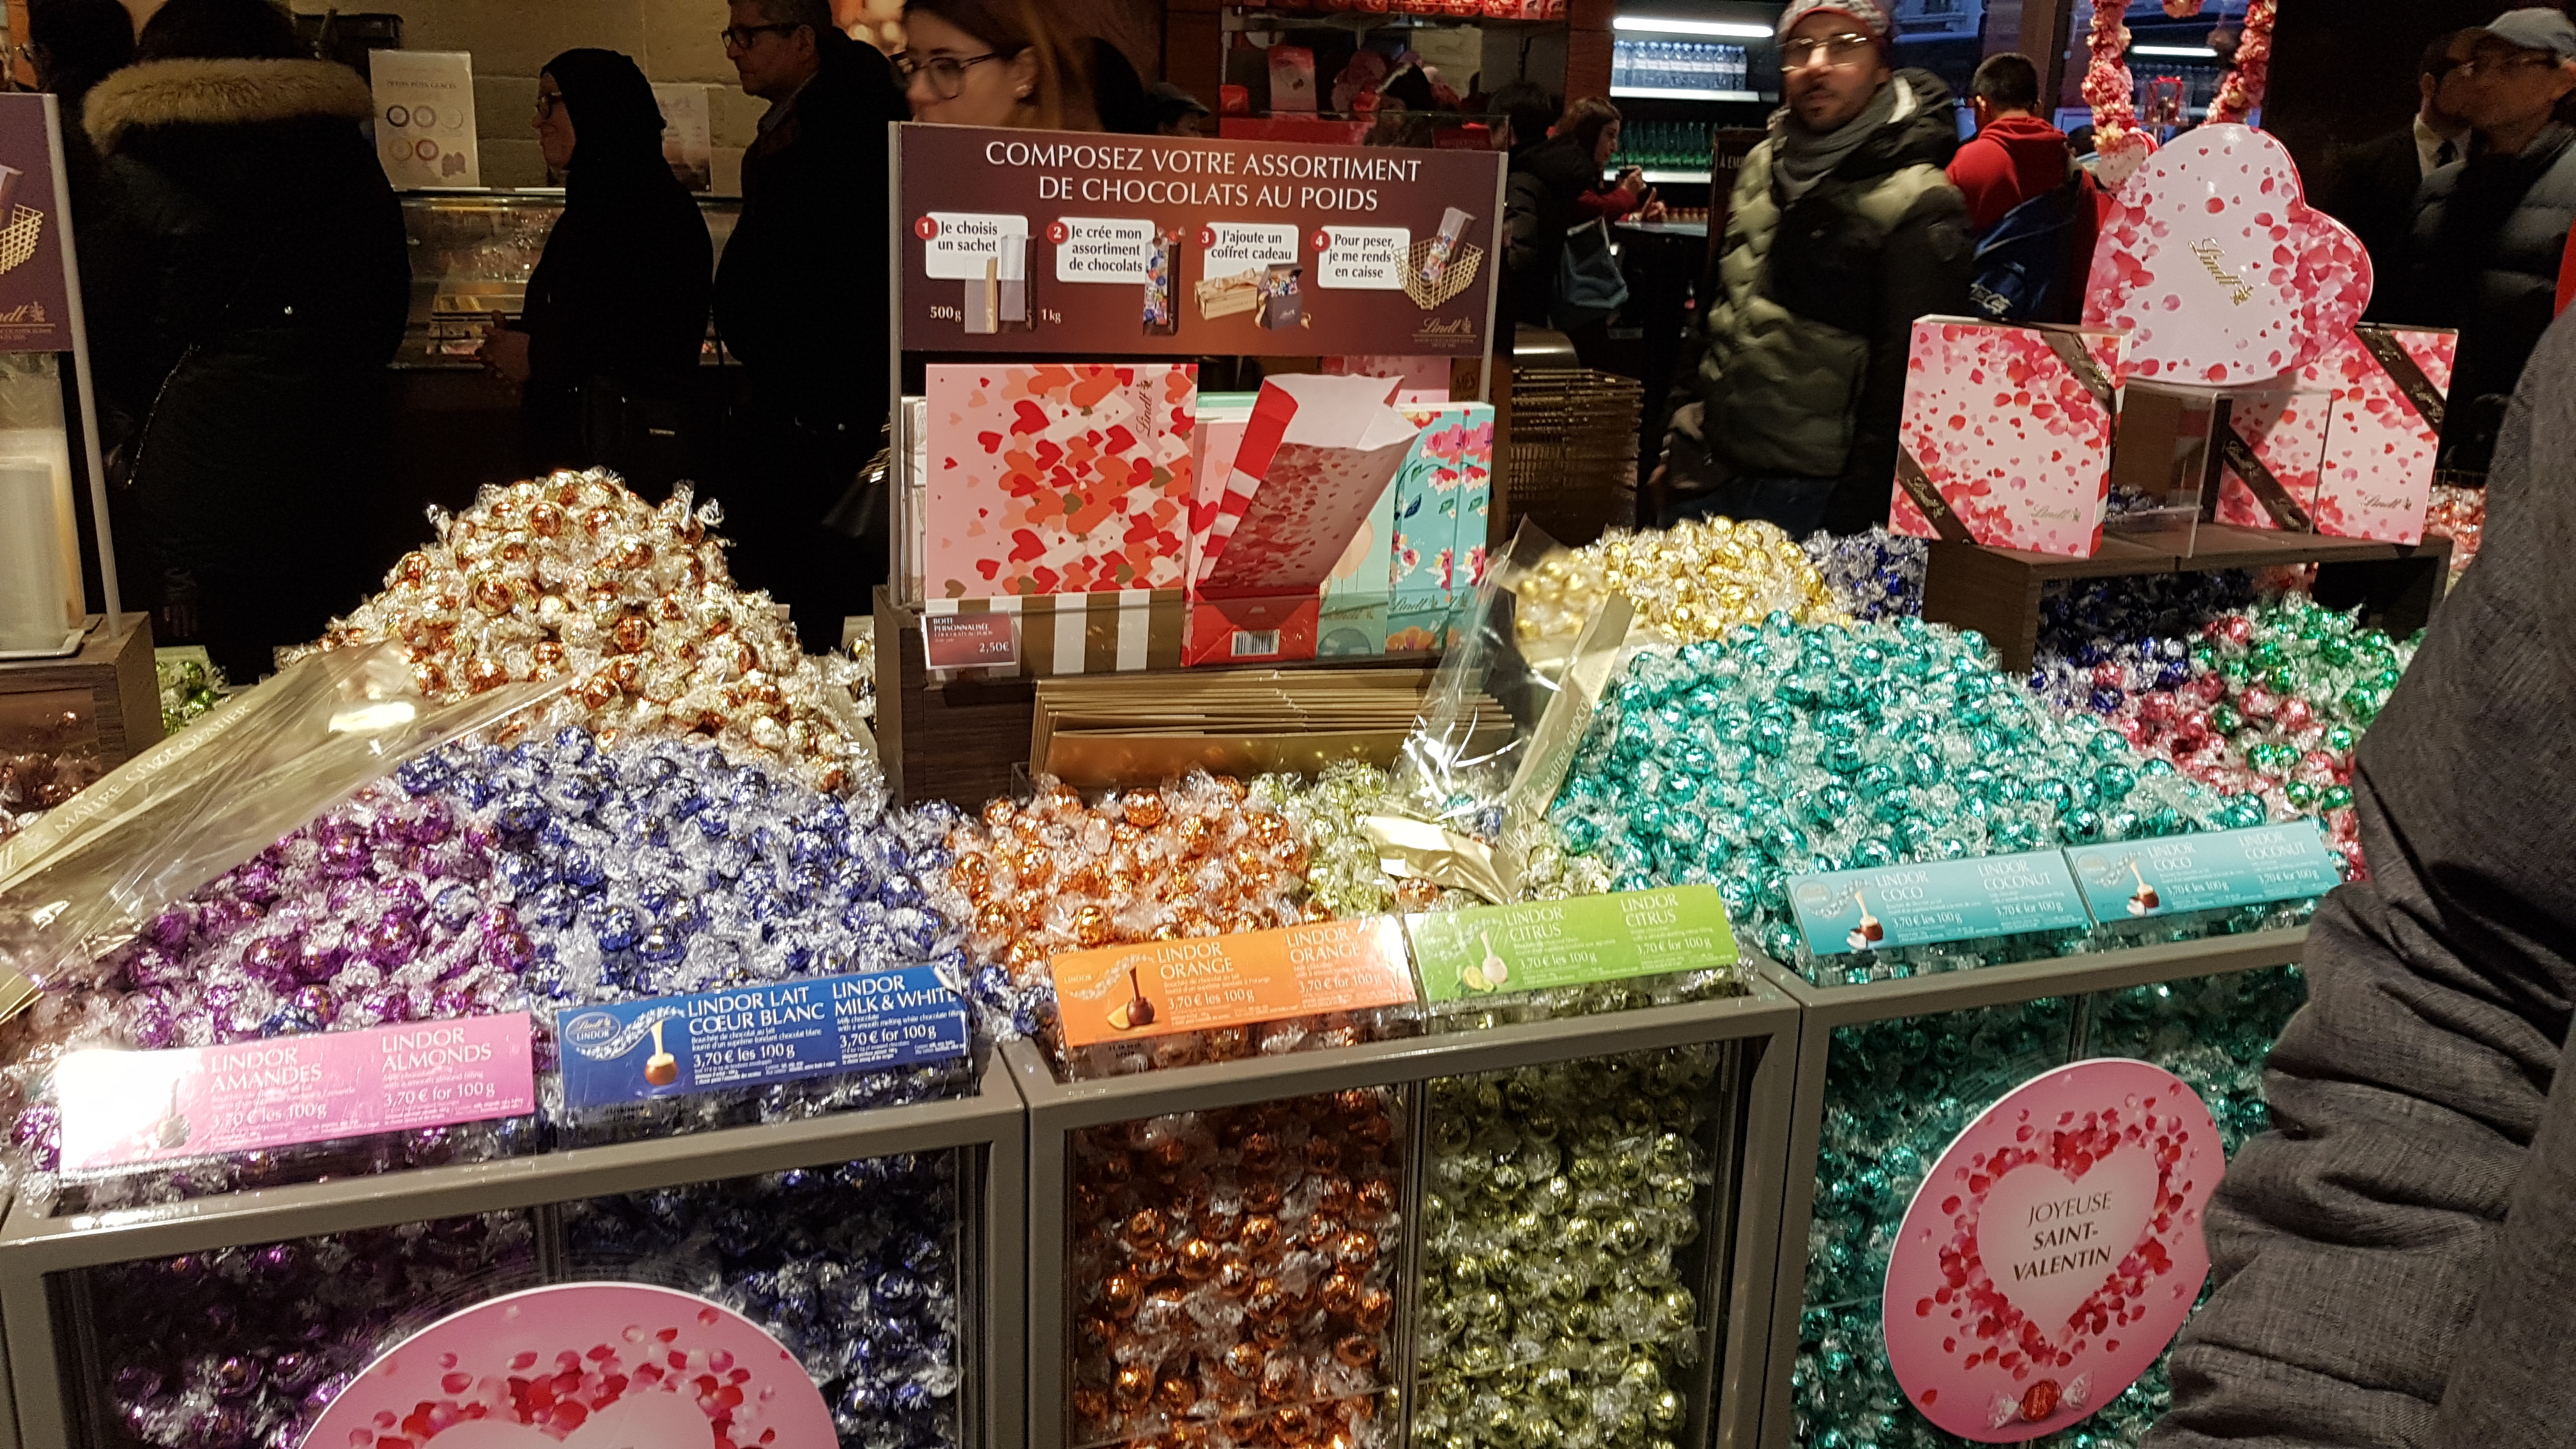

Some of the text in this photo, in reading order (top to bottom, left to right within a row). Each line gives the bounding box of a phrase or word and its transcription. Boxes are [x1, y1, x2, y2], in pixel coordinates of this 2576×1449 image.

[986, 141, 1422, 183] COMPOSEZ VOTRE ASSORTIMENT
[1039, 176, 1378, 211] DE CHOCOLATS AU POIDS
[940, 220, 998, 236] Je choisis
[1071, 225, 1142, 240] Je crée mon
[1222, 230, 1282, 245] J'ajoute un
[938, 238, 997, 252] un sachet
[1072, 241, 1140, 256] assortiment
[1334, 233, 1395, 250] Pour peser,
[1211, 247, 1292, 261] coffret cadeau
[1328, 250, 1391, 265] je me rends
[2188, 236, 2245, 288] Lindt
[1069, 259, 1142, 273] de chocolats
[1335, 266, 1383, 279] en caisse
[1136, 390, 1152, 438] Lindt
[2245, 841, 2306, 860] COCONUT
[1977, 859, 2030, 877] LINDOR
[2154, 856, 2192, 870] COCO
[1875, 870, 1929, 888] LINDOR
[1984, 871, 2051, 890] COCONUT
[1621, 893, 1678, 913] LINDOR
[1880, 885, 1924, 901] COCO
[1505, 906, 1565, 926] LINDOR
[1625, 908, 1676, 927] CITRUS
[1286, 927, 1351, 948] LINDOR
[1510, 923, 1561, 941] CITRUS
[1157, 942, 1223, 963] LINDOR
[1290, 943, 1360, 965] ORANGE
[1160, 956, 1234, 980] ORANGE
[832, 975, 905, 999] LINDOR
[688, 986, 809, 1018] LINDOR LAIT
[835, 995, 878, 1016] MILK
[882, 994, 894, 1011] &
[689, 1002, 825, 1036] CŒUR BLANC
[382, 1027, 464, 1053] LINDOR
[576, 1029, 610, 1041] LINDOR
[211, 1047, 297, 1073] LINDOR
[382, 1042, 492, 1073] ALMONDS
[210, 1062, 323, 1094] AMANDES
[2026, 1190, 2112, 1229] JOYEUSE
[2033, 1221, 2099, 1251] SAINT-
[2012, 1245, 2112, 1282] VALENTIN
